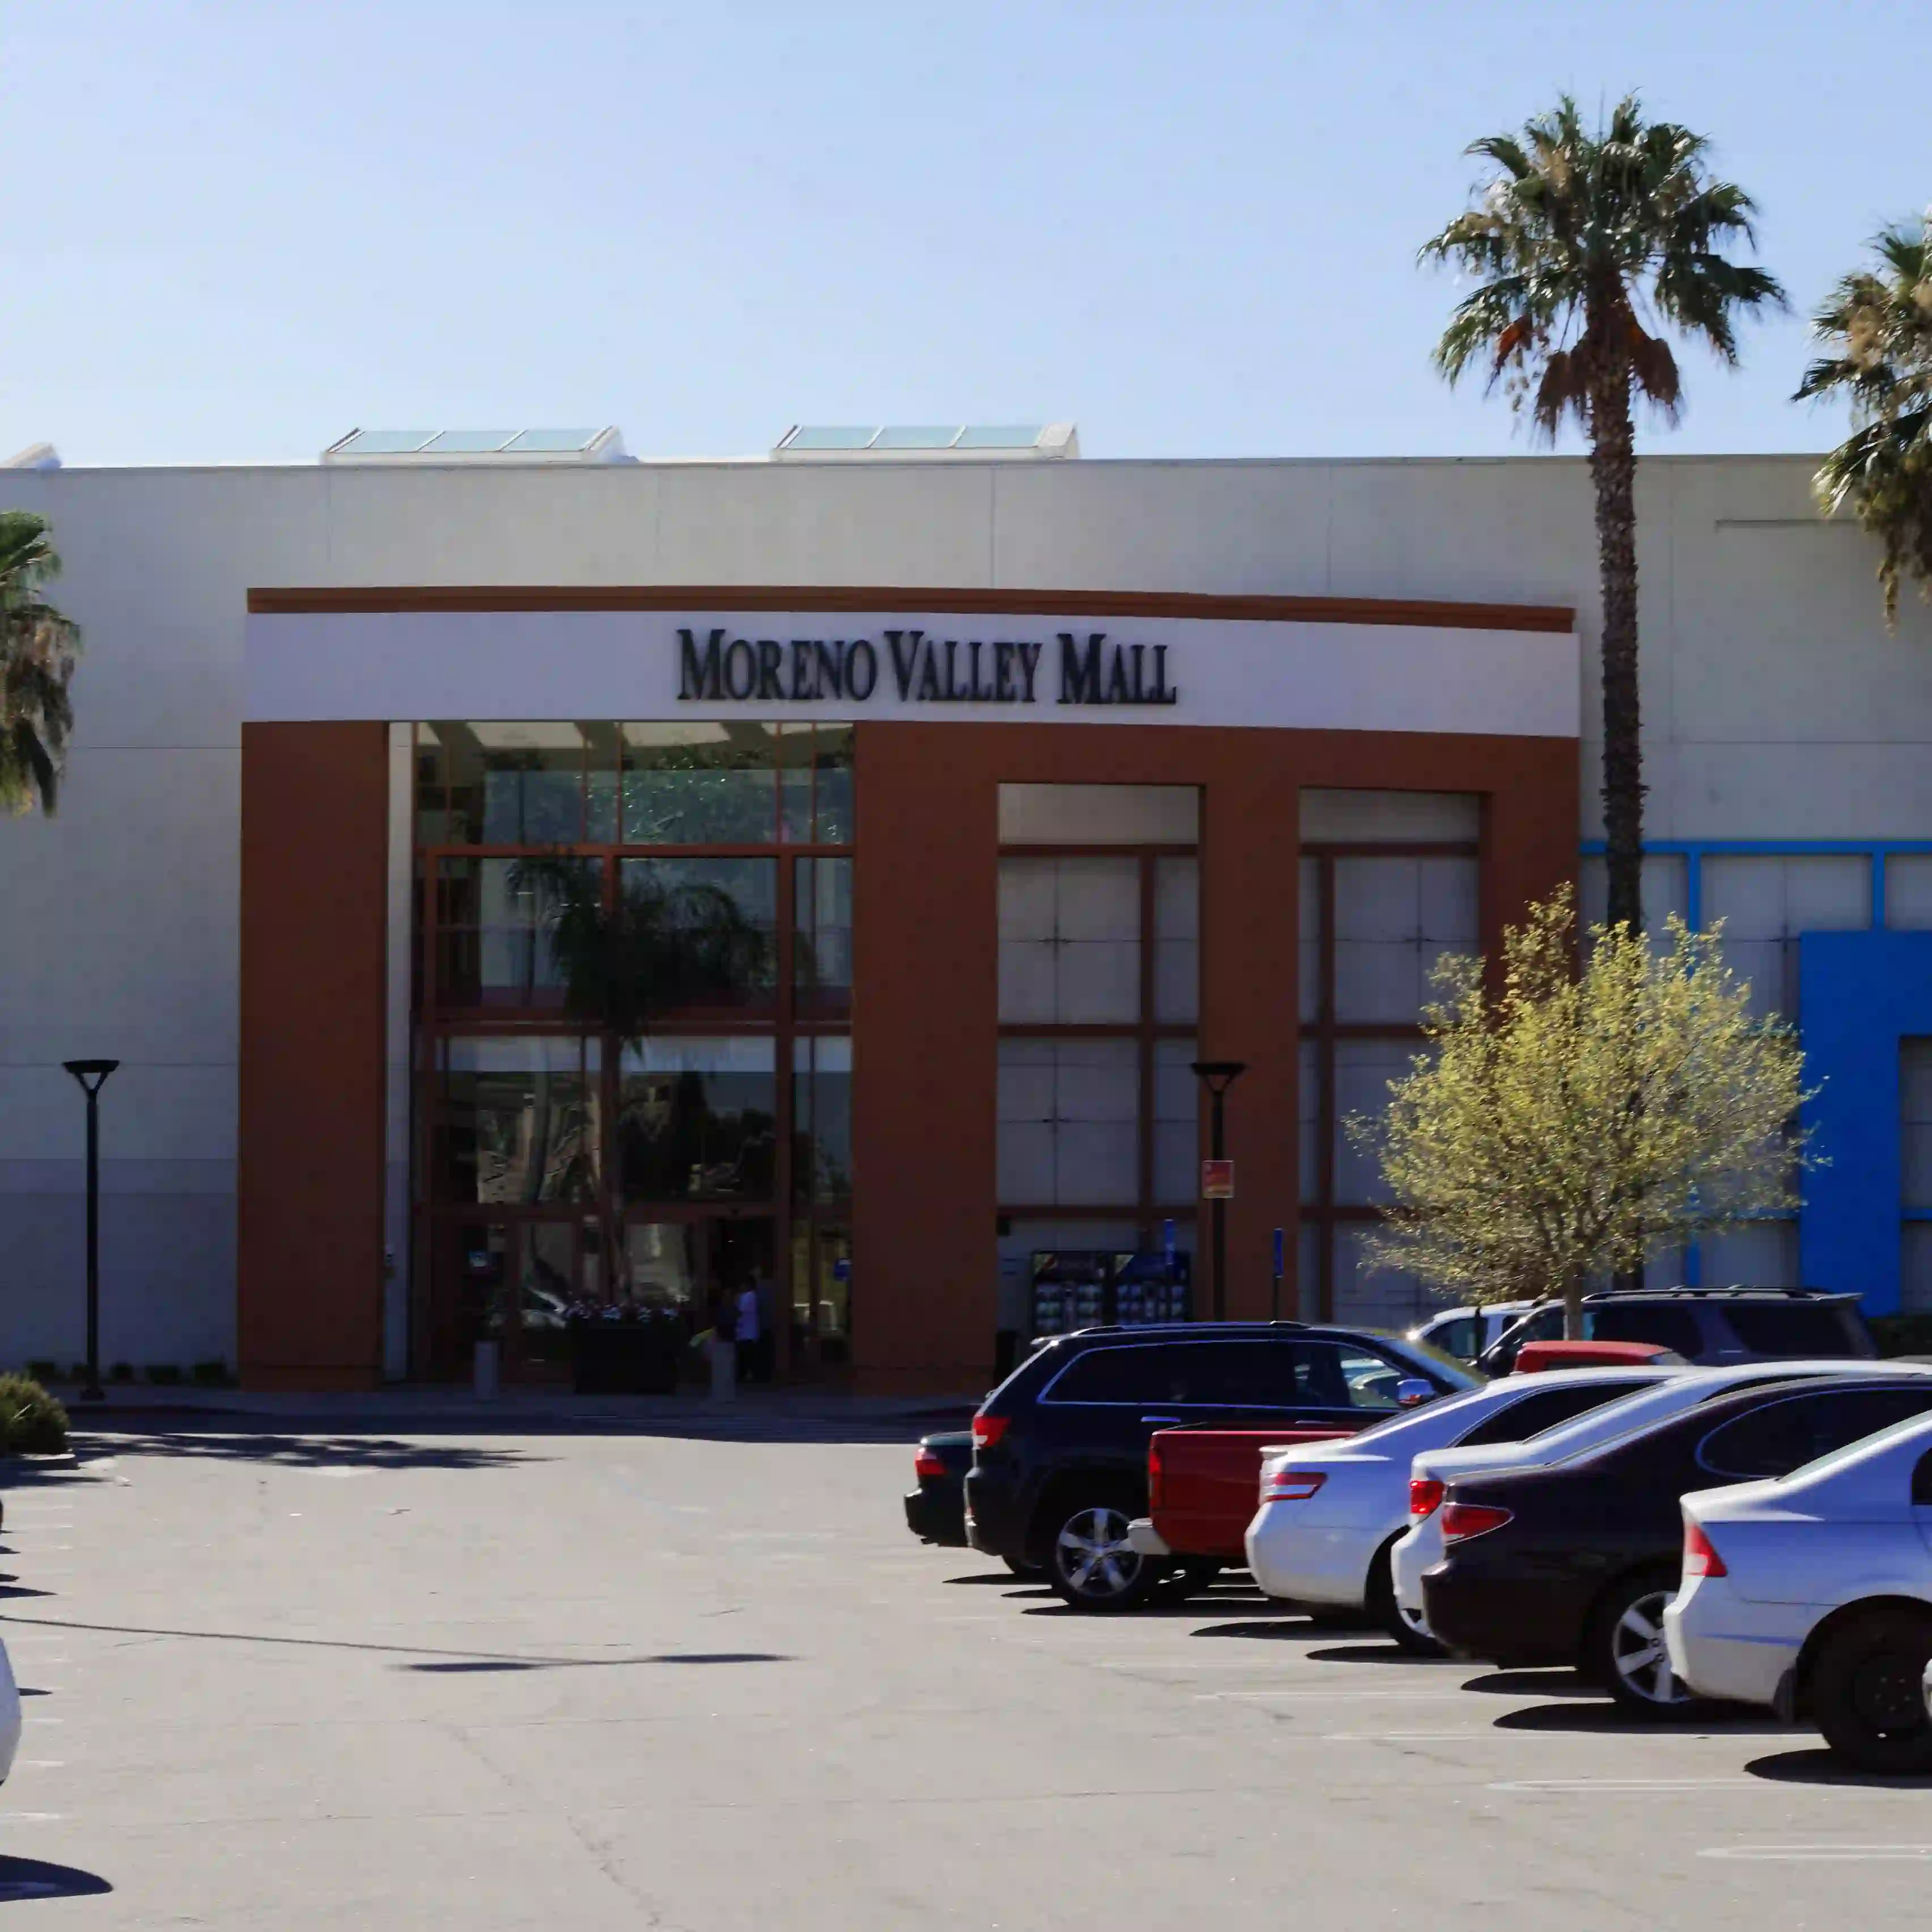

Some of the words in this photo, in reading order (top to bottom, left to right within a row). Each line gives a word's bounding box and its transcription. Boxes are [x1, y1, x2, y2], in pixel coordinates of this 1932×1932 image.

[677, 628, 878, 702] MORENO
[884, 630, 1043, 703] VALLEY
[1056, 633, 1177, 705] MALL
